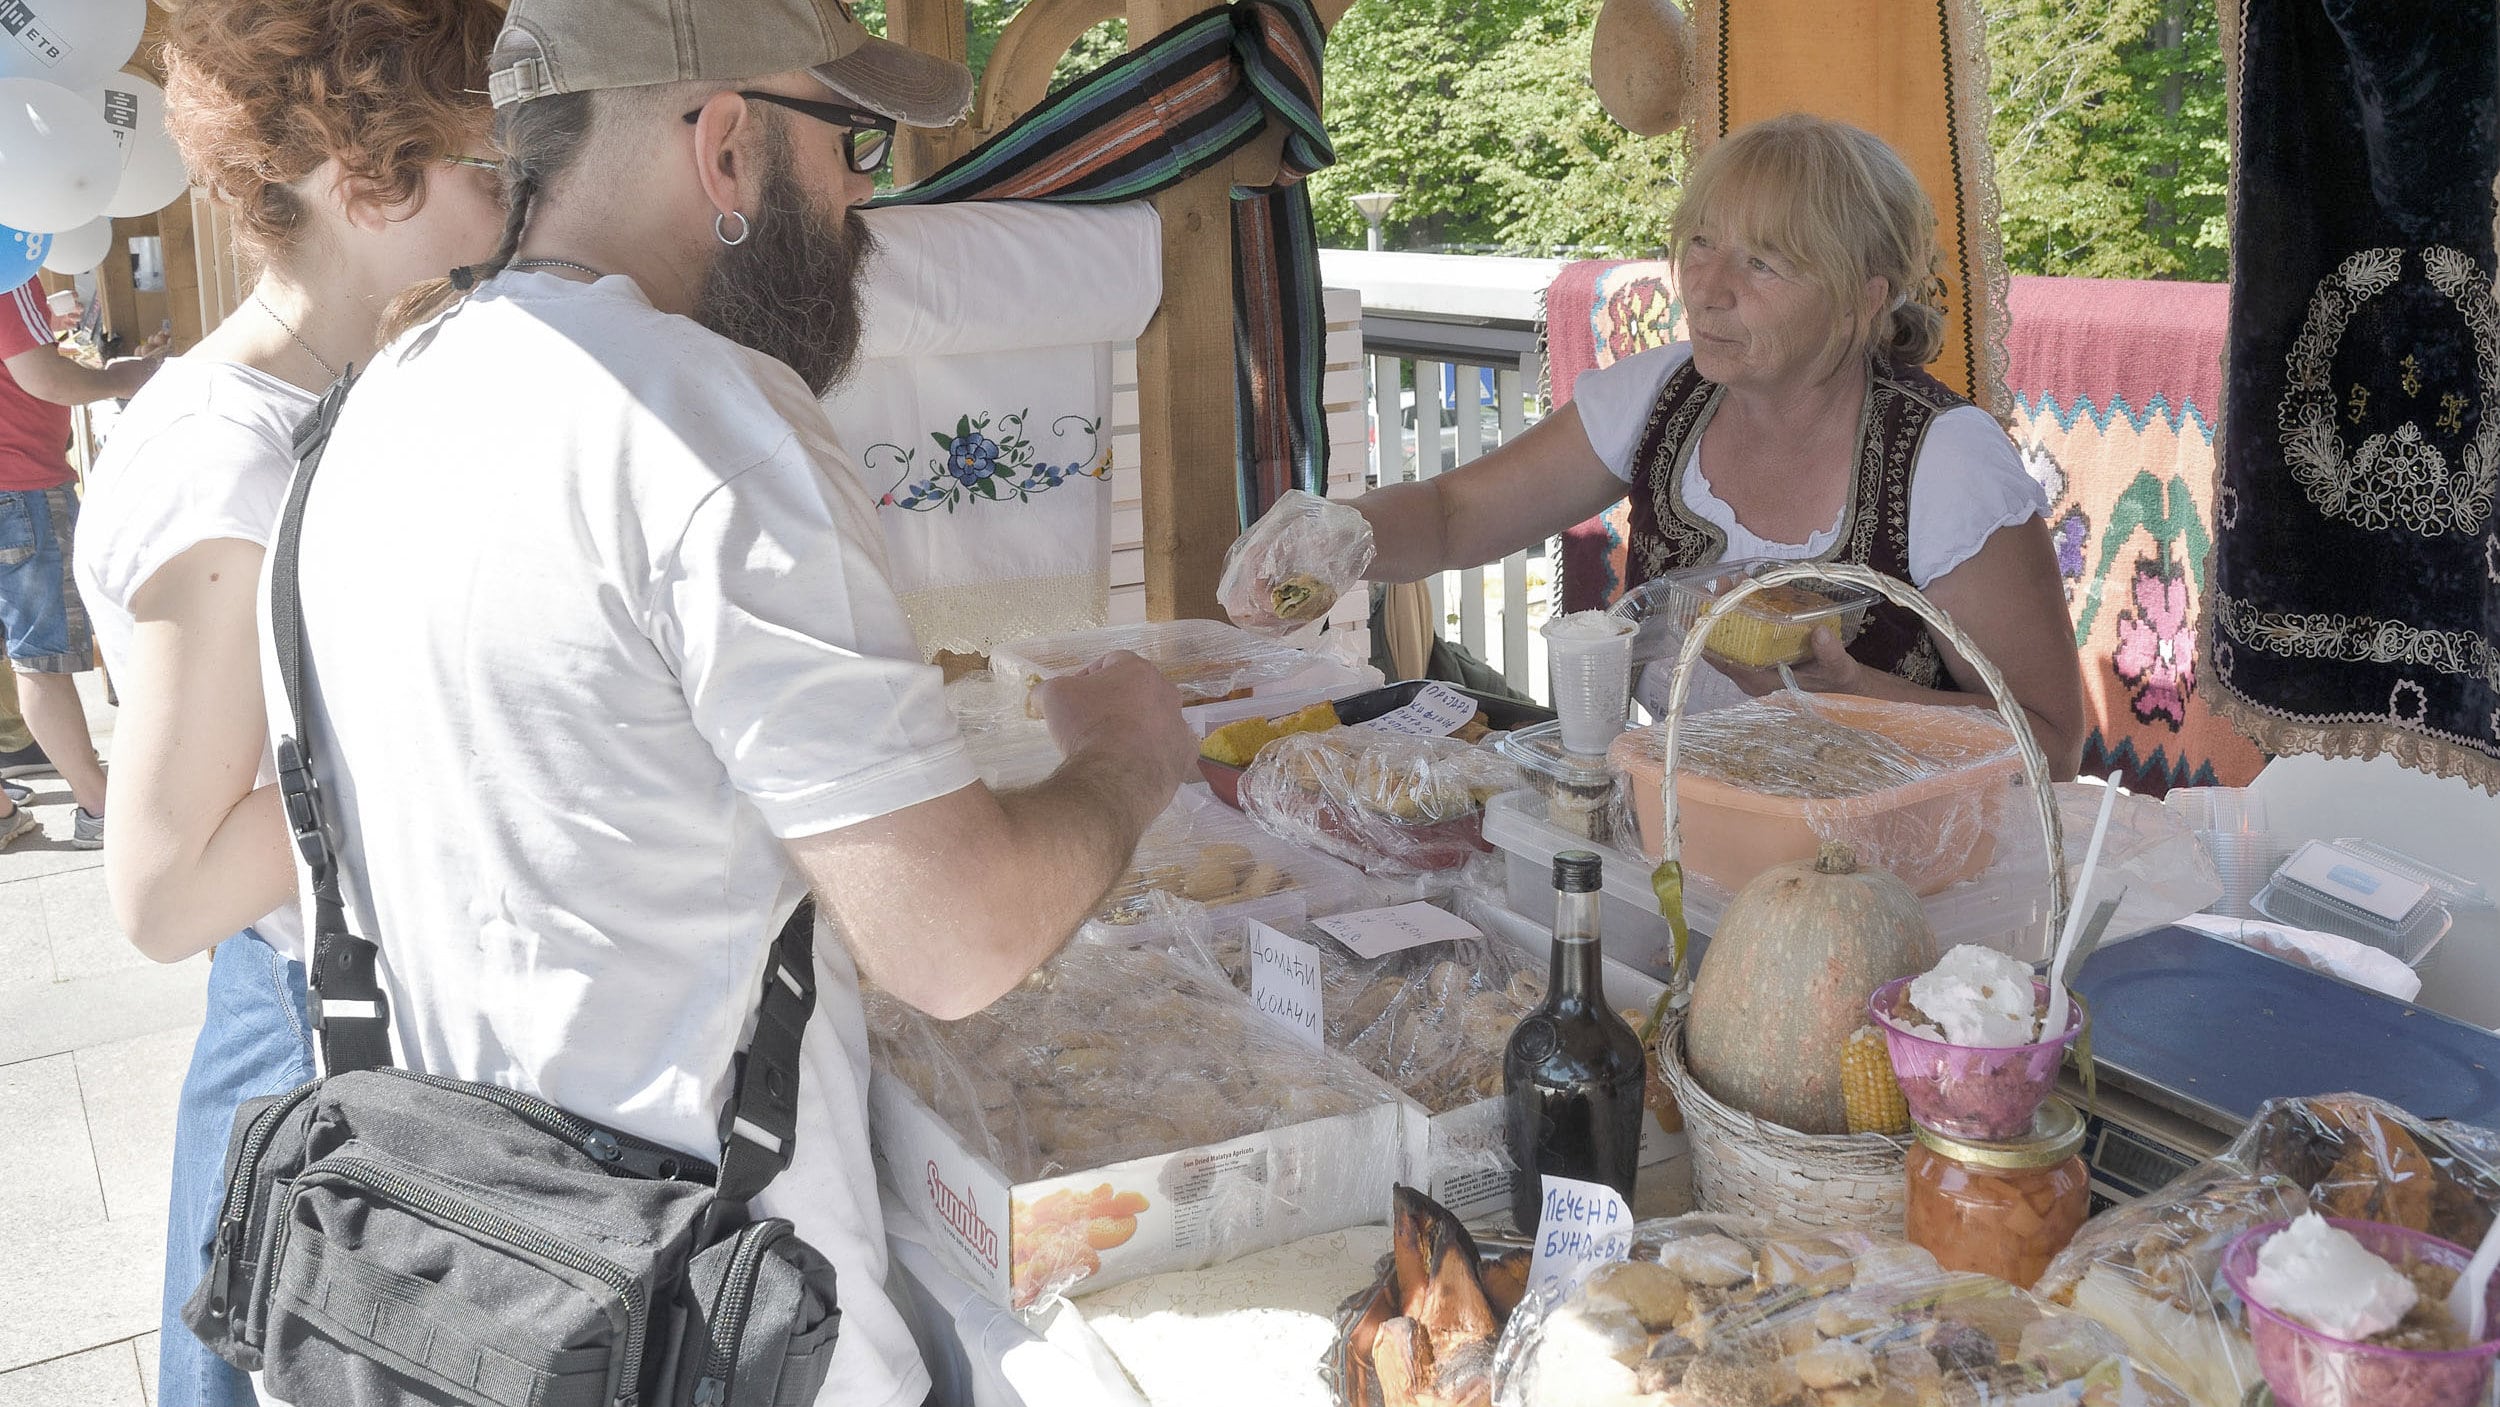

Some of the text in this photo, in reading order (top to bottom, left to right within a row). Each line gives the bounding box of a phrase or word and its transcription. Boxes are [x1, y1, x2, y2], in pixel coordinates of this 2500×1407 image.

[26, 27, 60, 59] ETB
[1252, 927, 1316, 991] ДОМАЋИ
[1256, 986, 1316, 1034] КОЛАЧИ
[1545, 1188, 1618, 1226] ПЕЧЕНА
